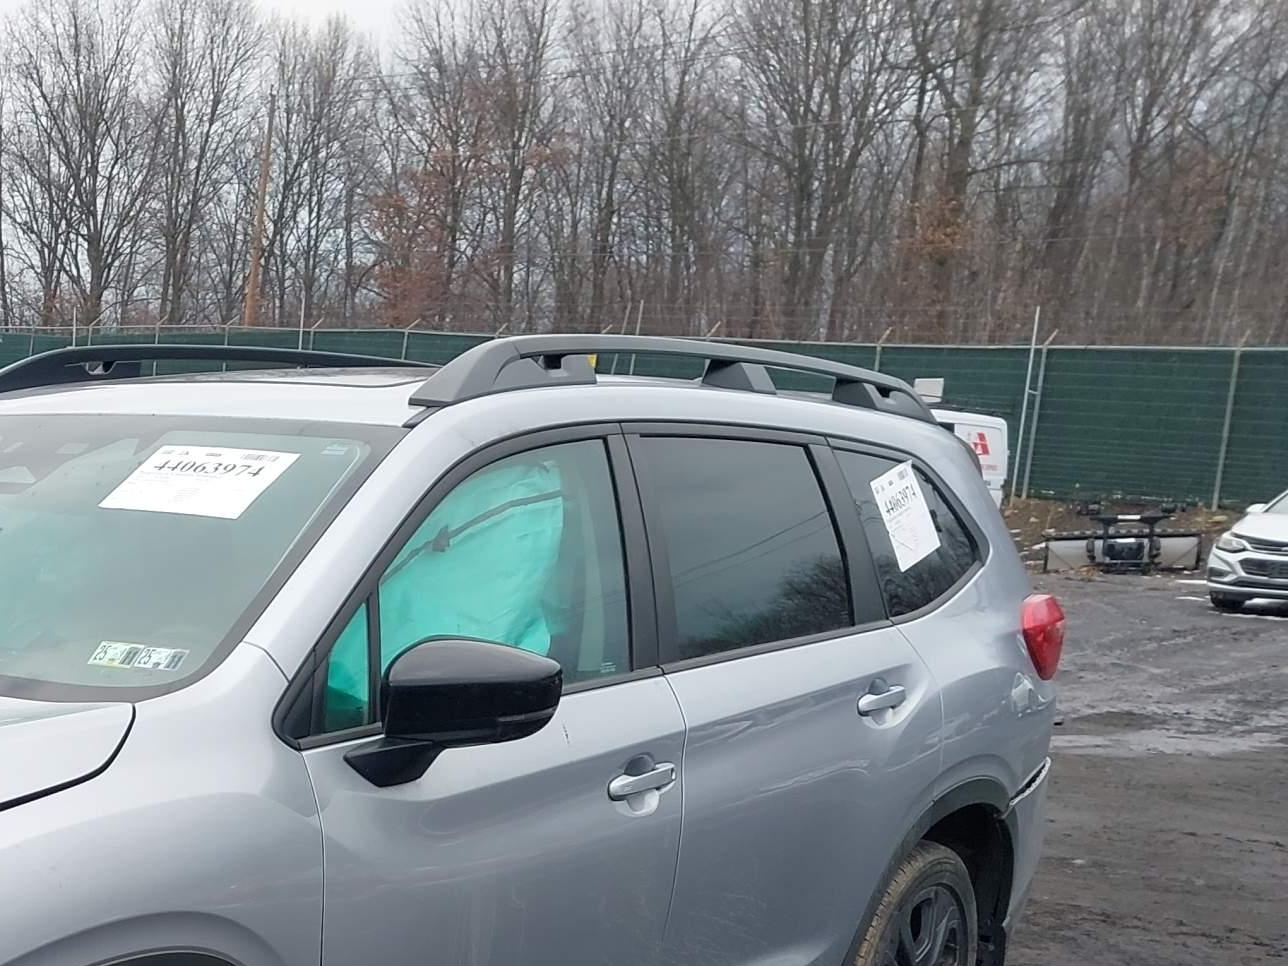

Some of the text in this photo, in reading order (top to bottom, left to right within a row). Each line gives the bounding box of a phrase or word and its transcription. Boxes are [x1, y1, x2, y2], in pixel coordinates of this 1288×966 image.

[154, 459, 266, 478] 44063974
[93, 645, 112, 661] 25
[137, 648, 157, 665] 25
